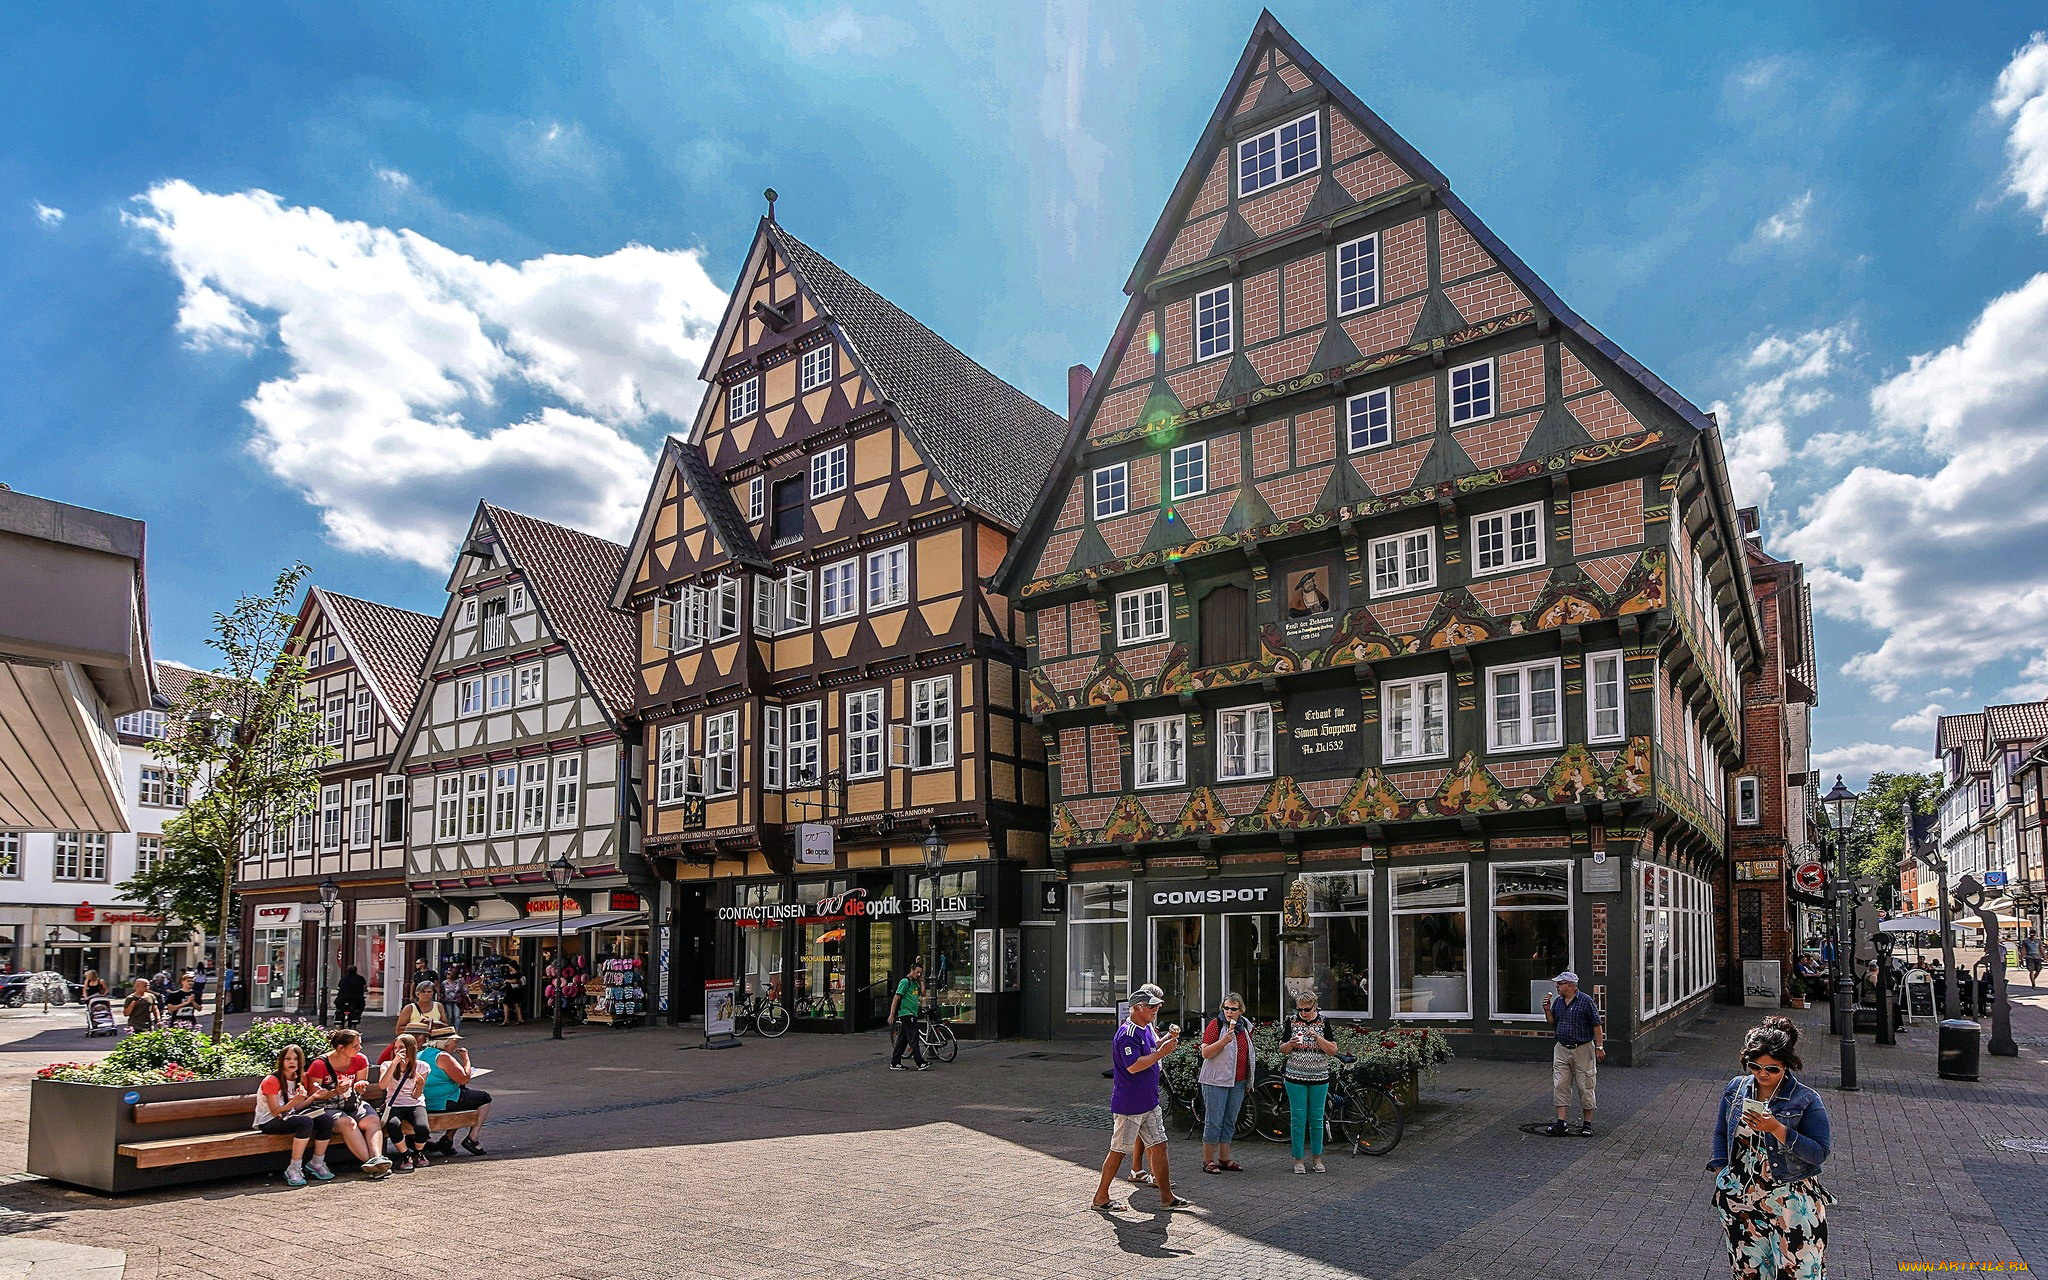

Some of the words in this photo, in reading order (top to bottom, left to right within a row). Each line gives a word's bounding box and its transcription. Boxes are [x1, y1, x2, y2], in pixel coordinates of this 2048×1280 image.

[1304, 707, 1331, 721] Erbaut
[1334, 707, 1345, 719] für
[1294, 726, 1319, 739] Simon
[1320, 723, 1357, 737] Hoppener
[815, 849, 830, 859] optik
[1153, 887, 1268, 905] COMSPOT
[718, 904, 806, 919] CONTACTLINSEN
[844, 901, 865, 916] die
[866, 896, 901, 920] optik
[667, 911, 672, 921] 7
